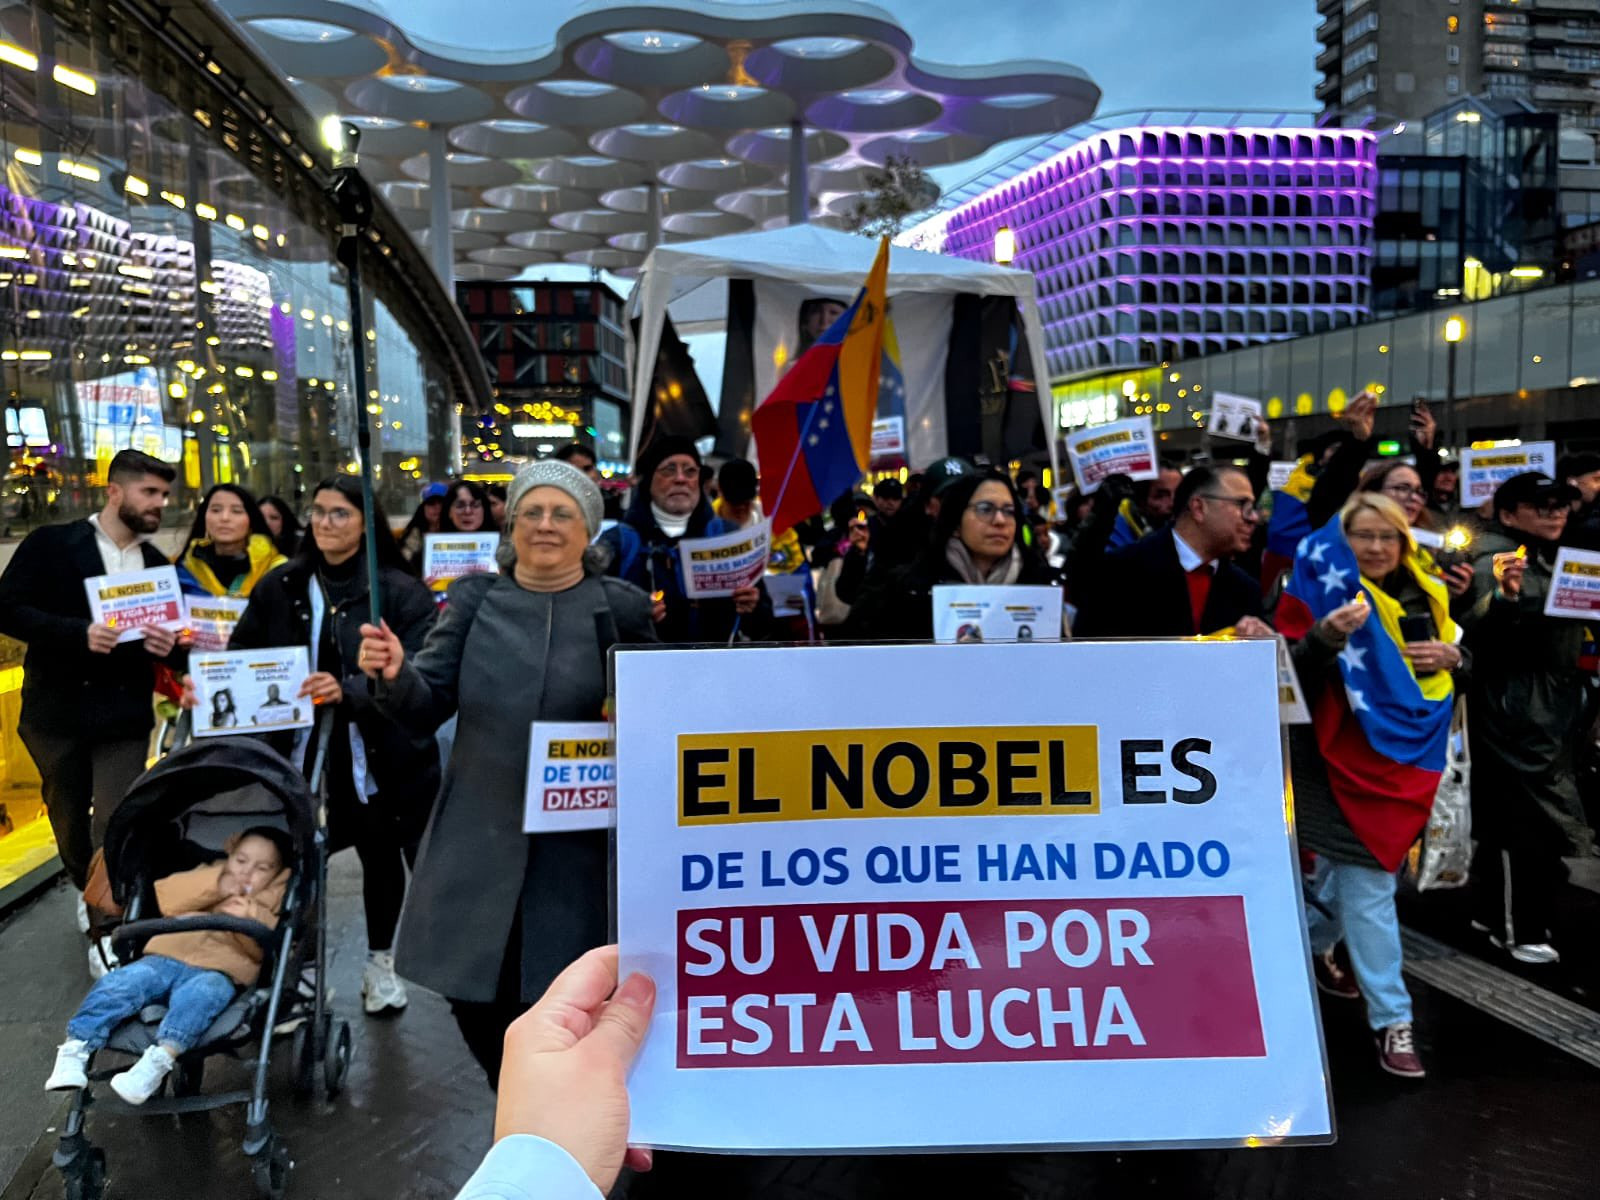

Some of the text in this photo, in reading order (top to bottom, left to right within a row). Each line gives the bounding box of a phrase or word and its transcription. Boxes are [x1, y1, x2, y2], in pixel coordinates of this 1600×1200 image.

[1132, 431, 1145, 441] ES
[1530, 454, 1544, 464] ES
[691, 533, 766, 560] EL NOBEL ES
[692, 564, 706, 573] DE
[710, 562, 730, 572] LAS
[118, 581, 154, 597] NOBEL
[158, 579, 171, 591] ES
[549, 741, 570, 759] EL
[543, 766, 571, 783] DE
[683, 738, 1217, 817] EL NOBEL ES
[682, 840, 1231, 892] DE LOS QUE HAN DADO
[685, 908, 1154, 977] SU VIDA POR
[687, 986, 1147, 1056] ESTA LUCHA
